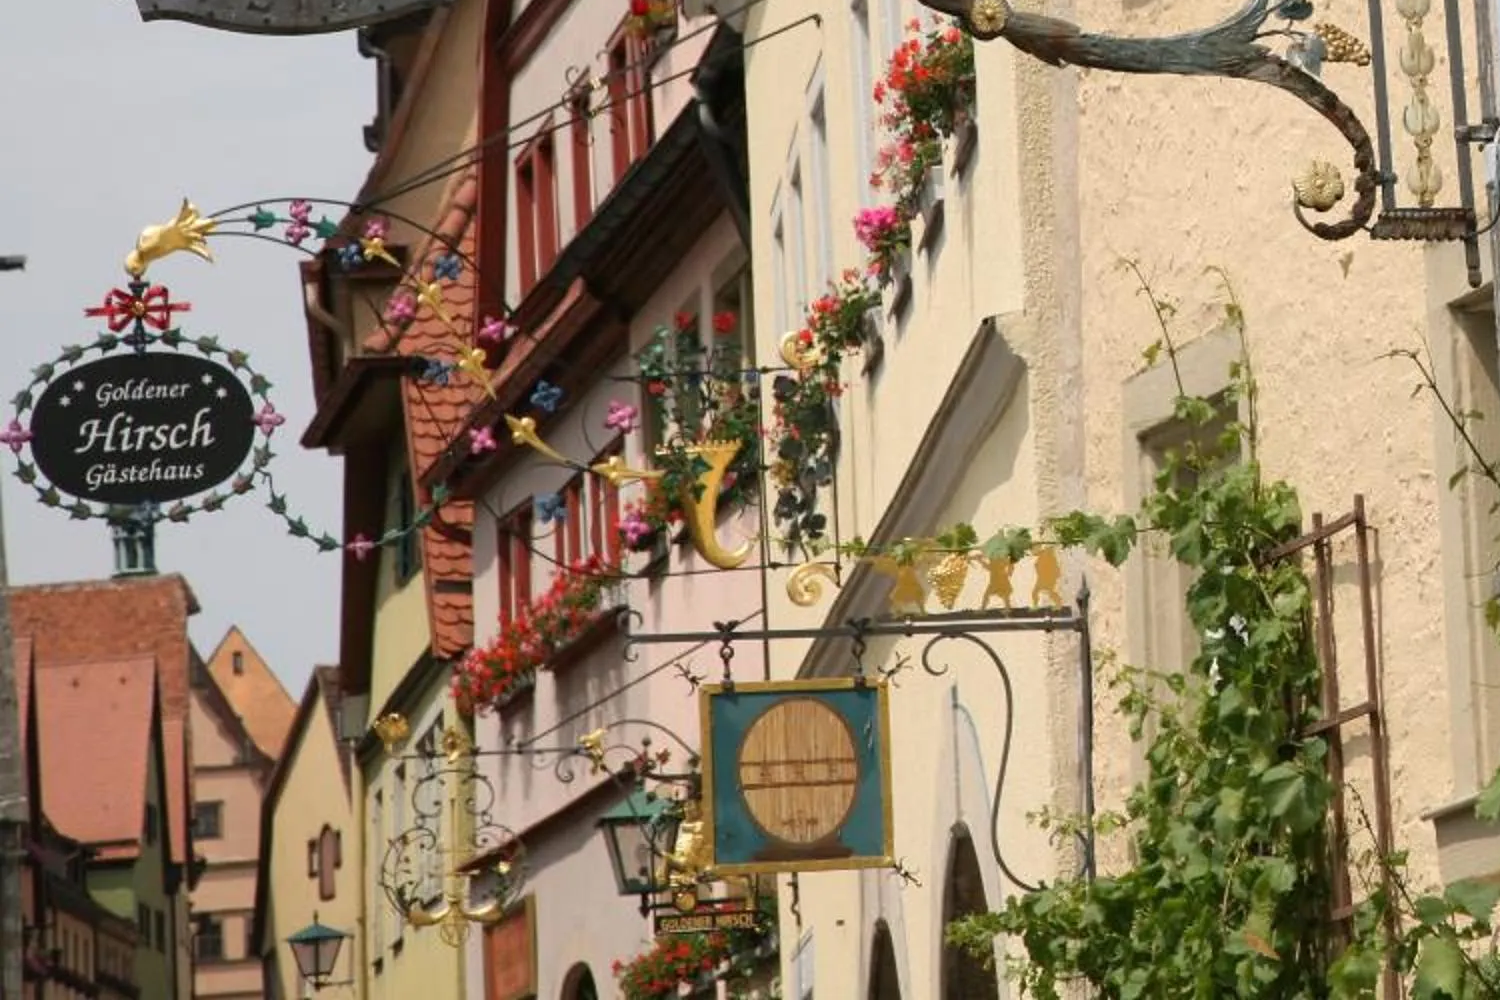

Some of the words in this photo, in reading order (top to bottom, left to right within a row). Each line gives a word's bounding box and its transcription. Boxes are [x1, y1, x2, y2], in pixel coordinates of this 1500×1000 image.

[95, 378, 190, 408] Goldener
[74, 407, 215, 454] Hirsch
[86, 458, 204, 491] Gästehaus
